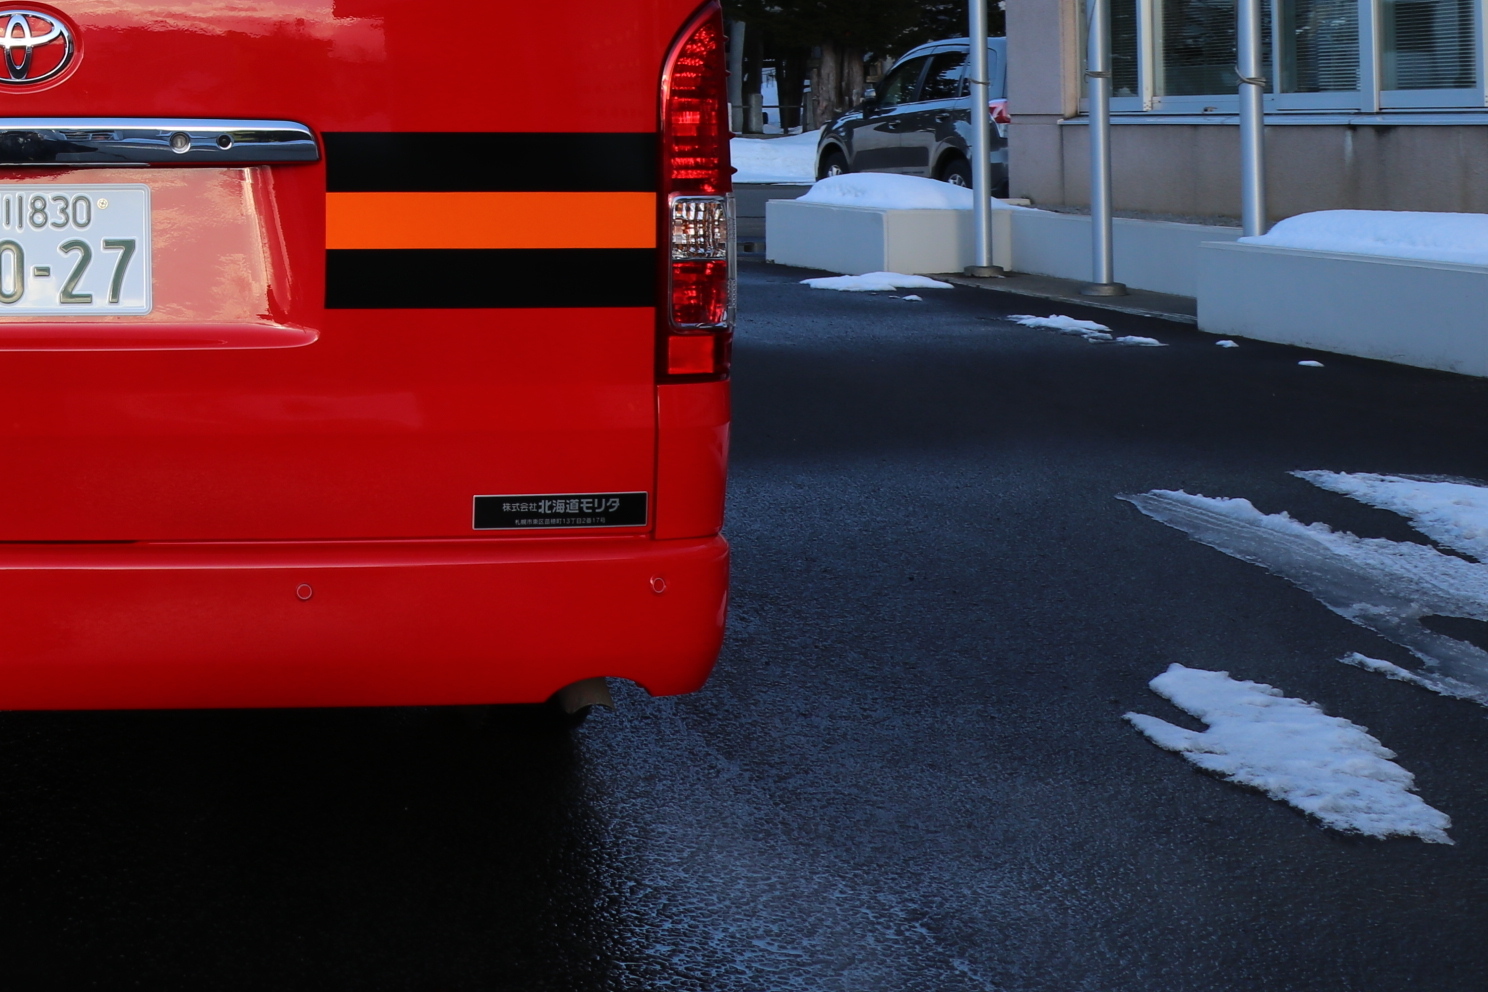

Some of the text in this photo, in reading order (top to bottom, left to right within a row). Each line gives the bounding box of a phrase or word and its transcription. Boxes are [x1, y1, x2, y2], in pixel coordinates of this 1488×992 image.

[502, 498, 620, 514] 株式会社北海道モリタ
